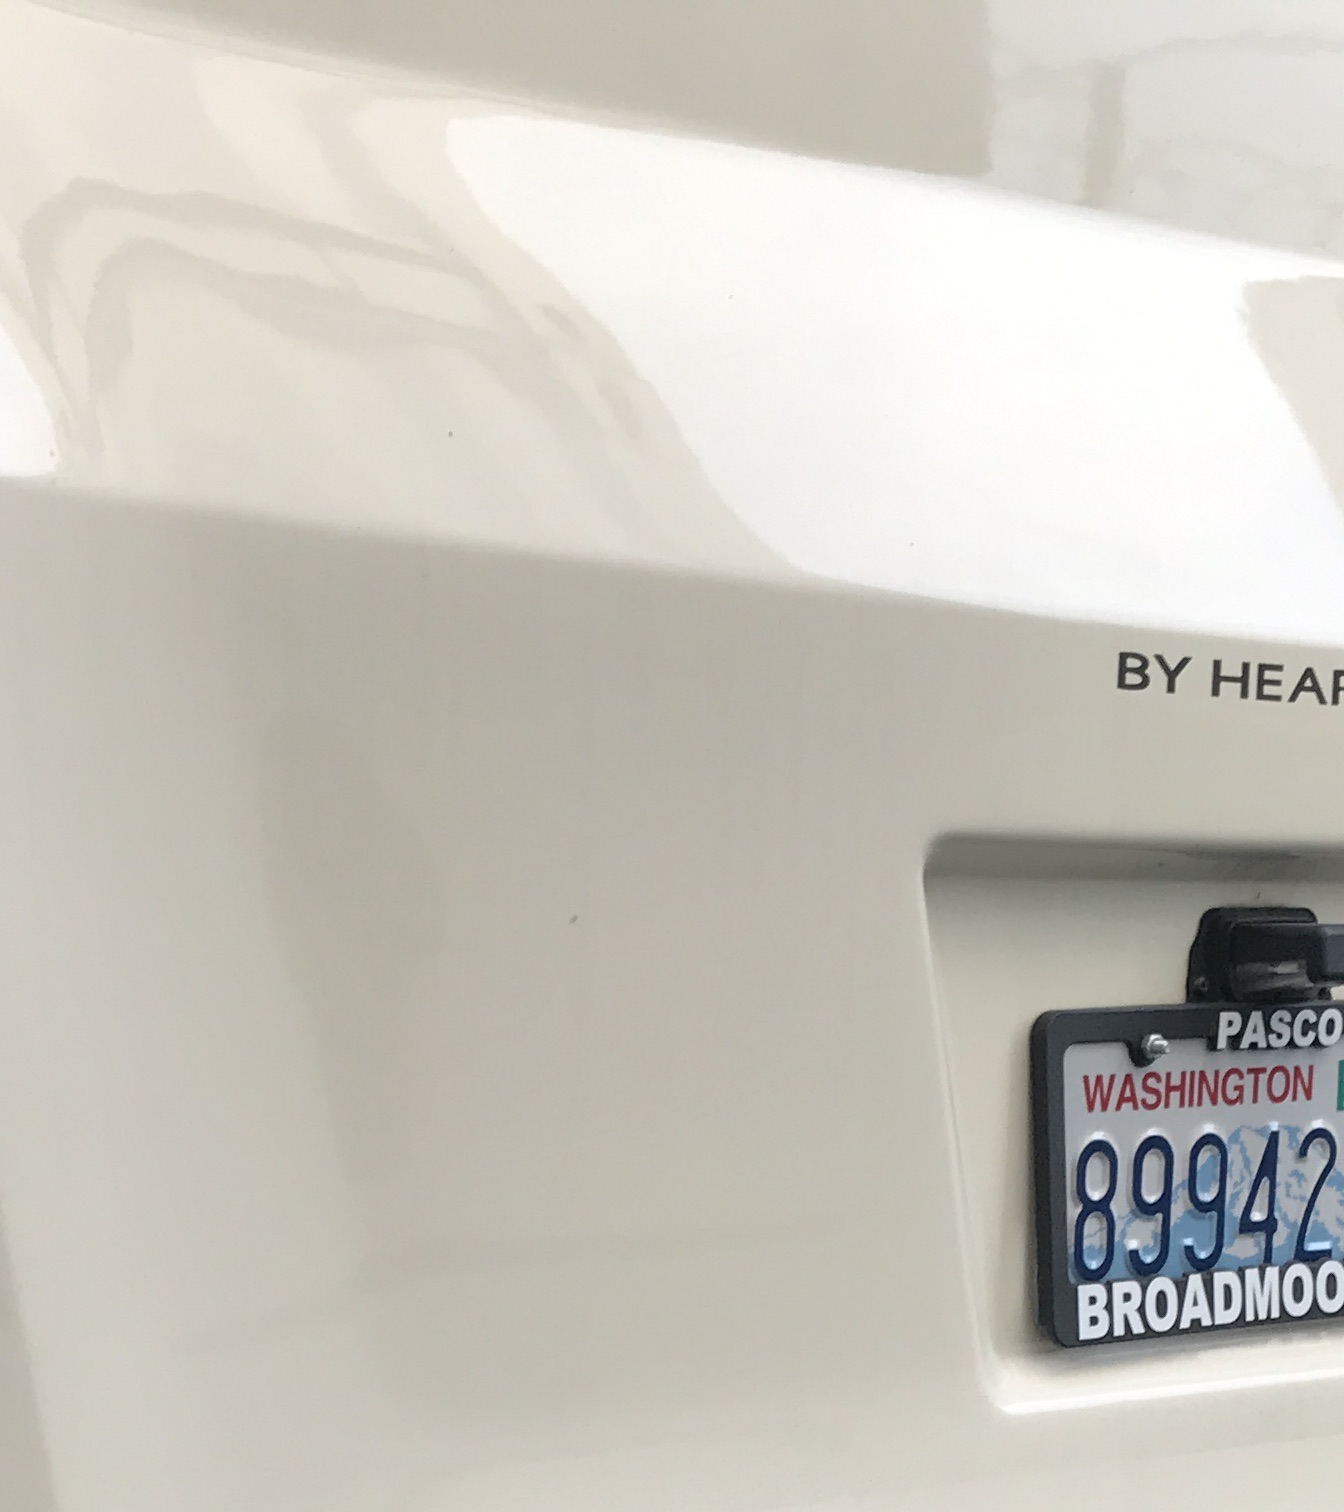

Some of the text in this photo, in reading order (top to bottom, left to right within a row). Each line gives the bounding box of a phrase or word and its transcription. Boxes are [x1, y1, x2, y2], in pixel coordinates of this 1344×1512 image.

[1116, 651, 1193, 694] BY
[1216, 1008, 1344, 1050] PASCO
[1083, 1064, 1315, 1113] WASHINGTON
